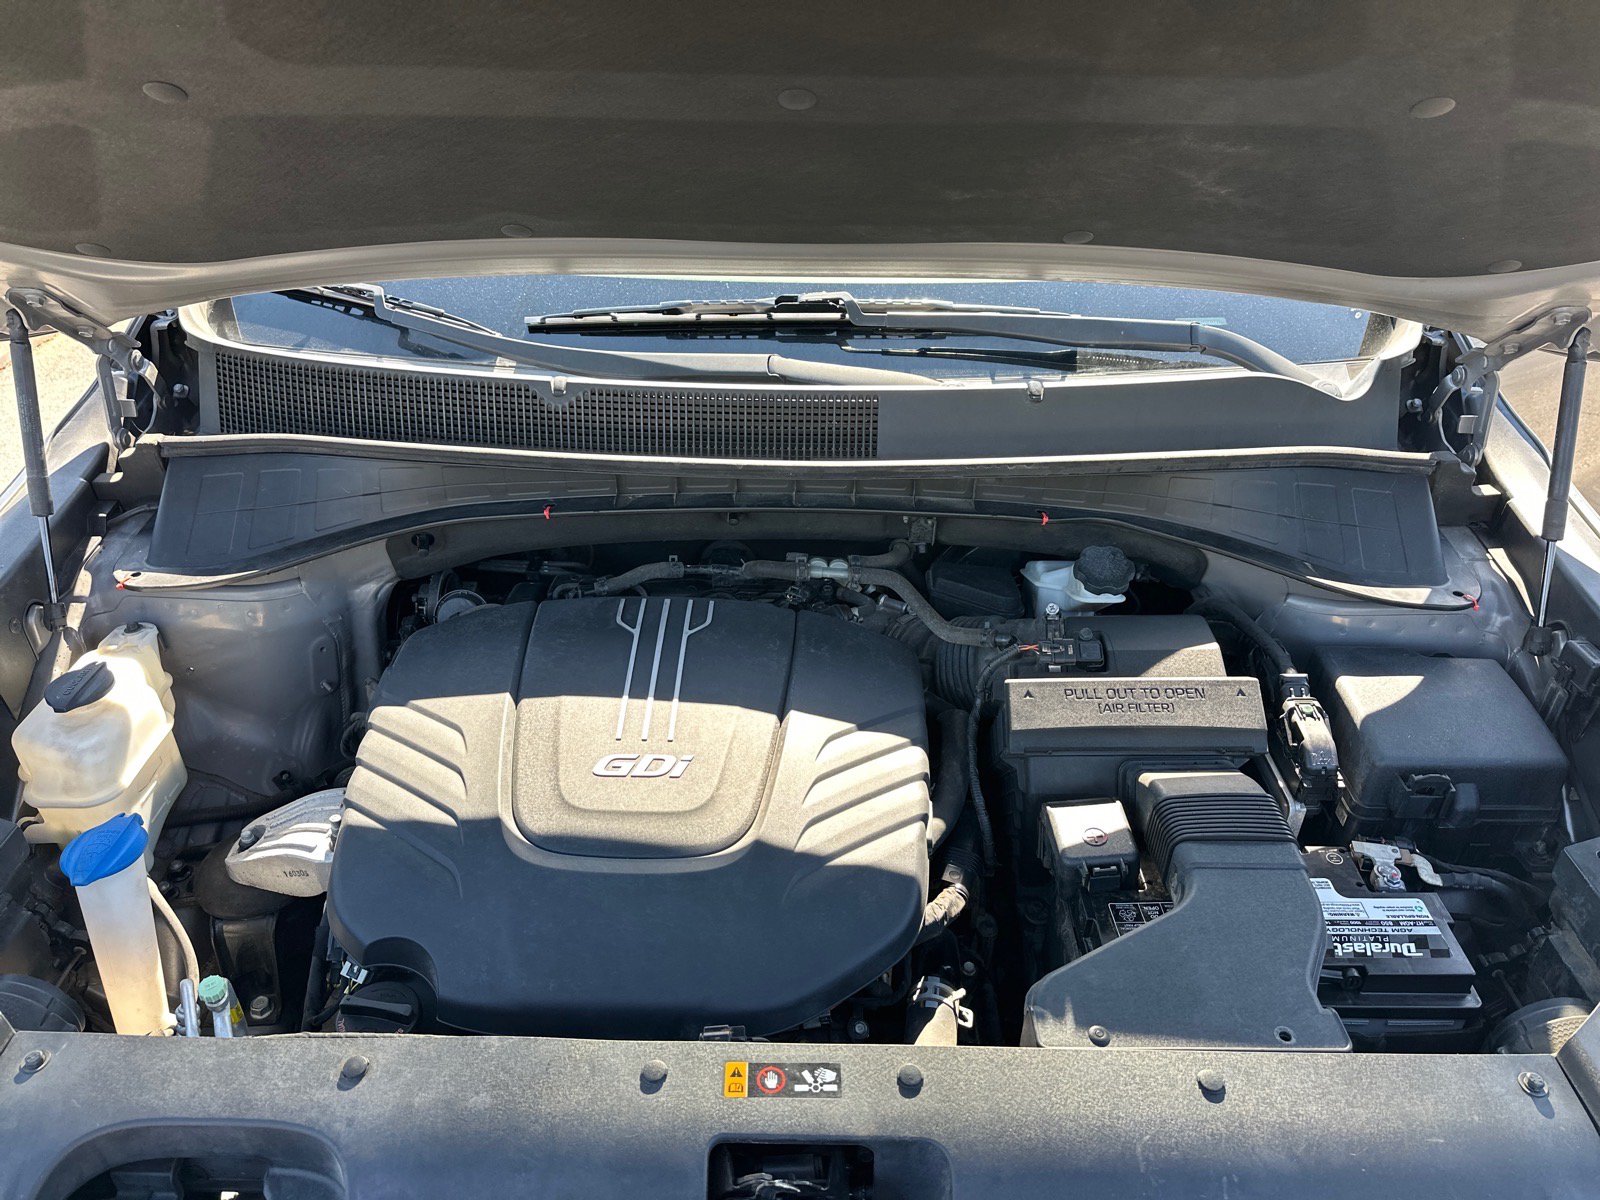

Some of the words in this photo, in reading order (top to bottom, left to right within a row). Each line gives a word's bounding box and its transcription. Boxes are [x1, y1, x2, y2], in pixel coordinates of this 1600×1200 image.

[1064, 688, 1103, 700] PULL
[1105, 688, 1136, 700] OUT
[1139, 688, 1161, 700] TO
[1165, 688, 1206, 700] OPEN
[592, 753, 695, 778] GDi
[1333, 942, 1423, 957] Duralast
